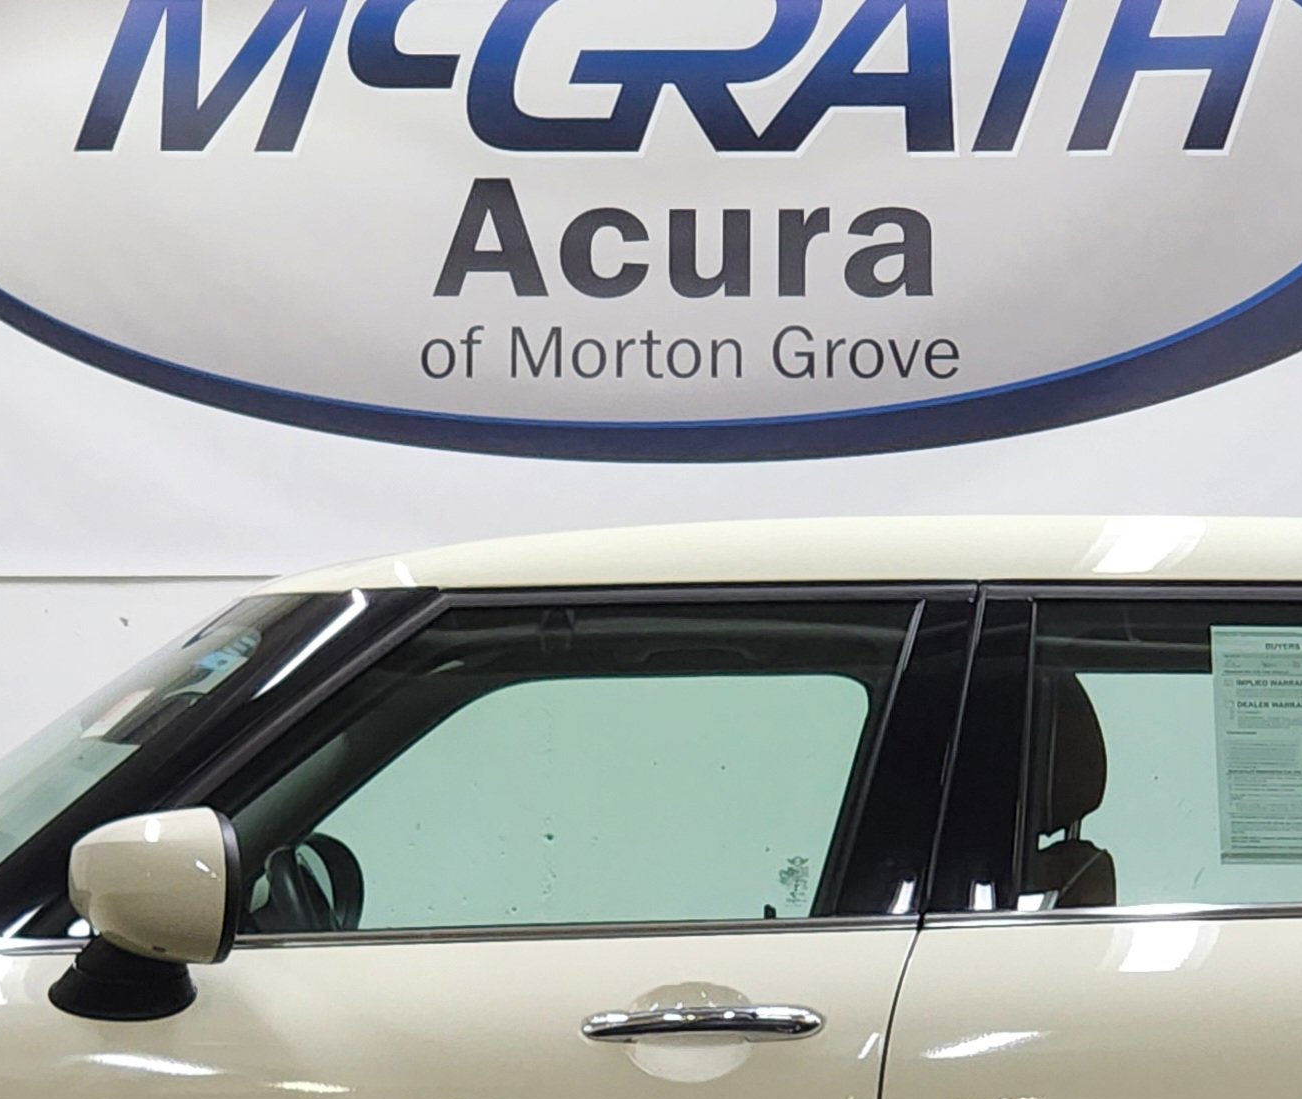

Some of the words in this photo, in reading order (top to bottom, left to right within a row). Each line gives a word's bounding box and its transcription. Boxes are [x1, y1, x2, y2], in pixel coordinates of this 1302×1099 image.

[433, 177, 934, 299] Acura
[420, 325, 485, 379] of
[510, 325, 744, 379] Morton
[772, 325, 960, 380] Grove
[1236, 701, 1270, 709] DEALER
